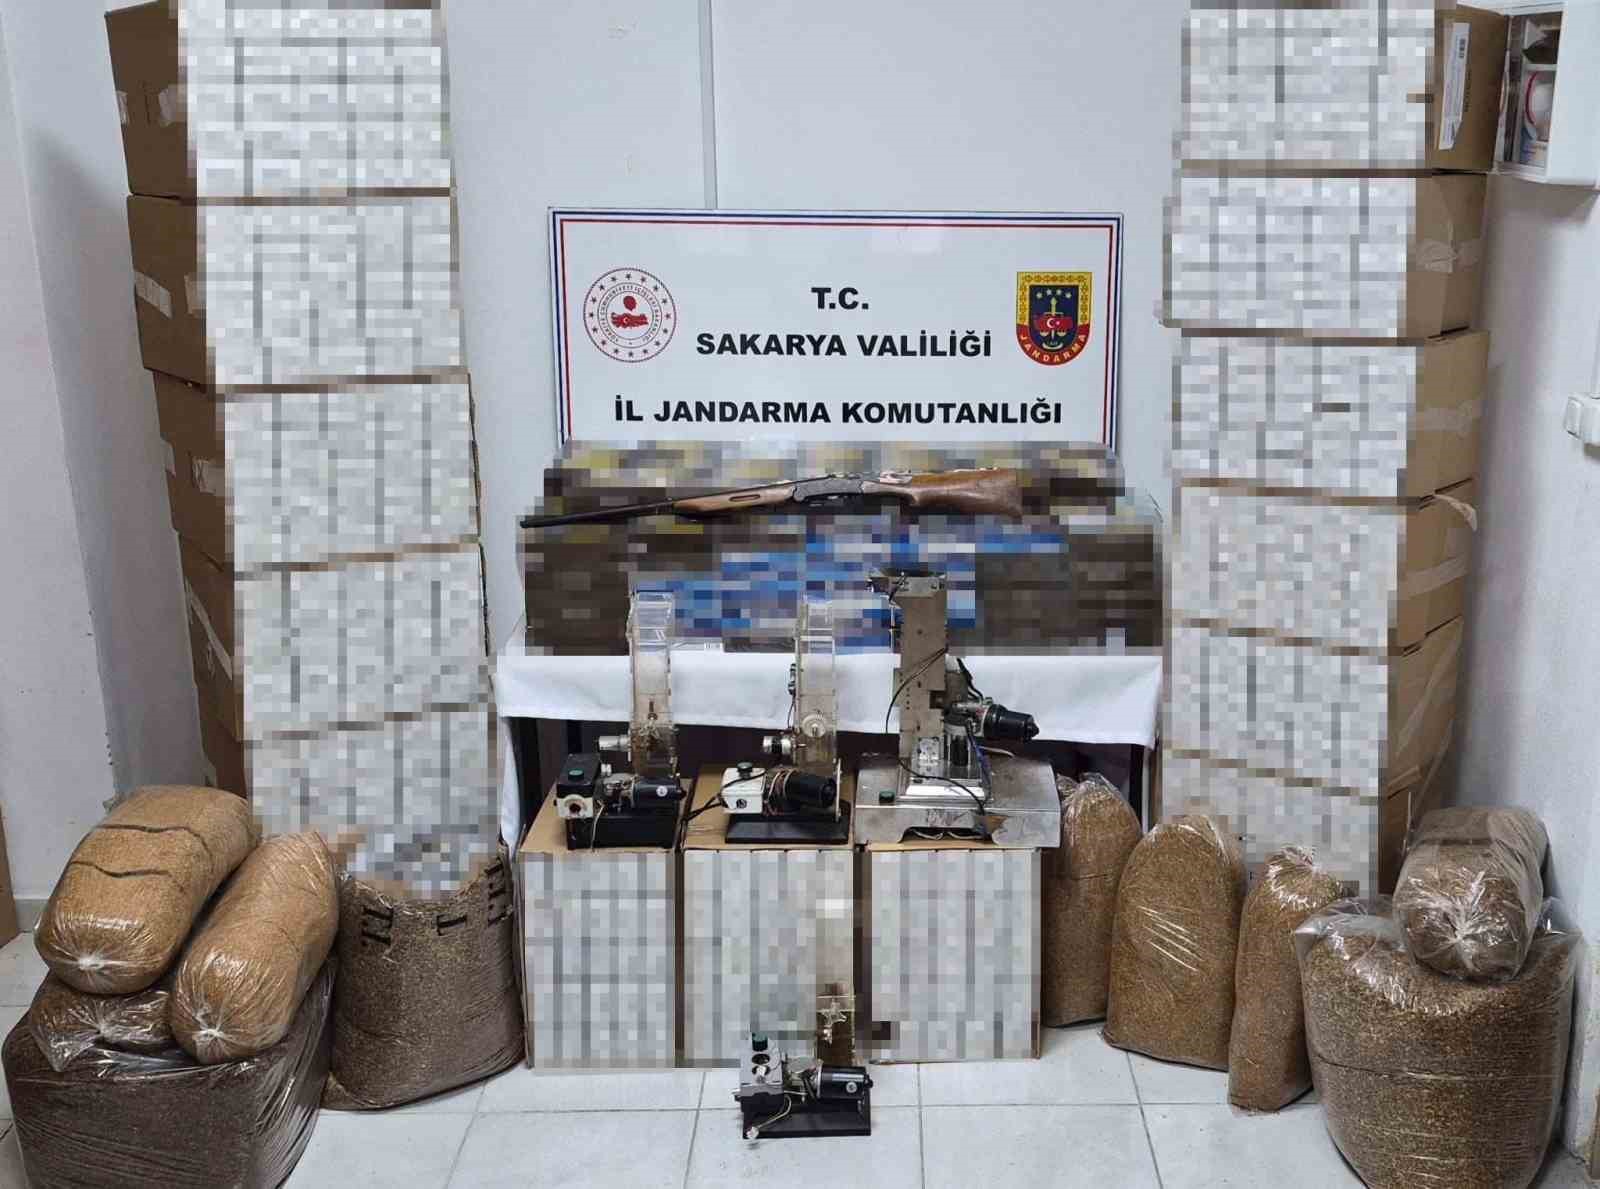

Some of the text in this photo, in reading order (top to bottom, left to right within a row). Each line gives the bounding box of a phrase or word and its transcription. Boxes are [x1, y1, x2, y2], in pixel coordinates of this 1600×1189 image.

[811, 287, 869, 310] T.C.
[696, 329, 991, 357] SAKARYA VALİLİĞİ
[1019, 334, 1086, 362] JANDARMA
[615, 394, 1062, 424] İL JANDARMA KOMUTANLIĞI
